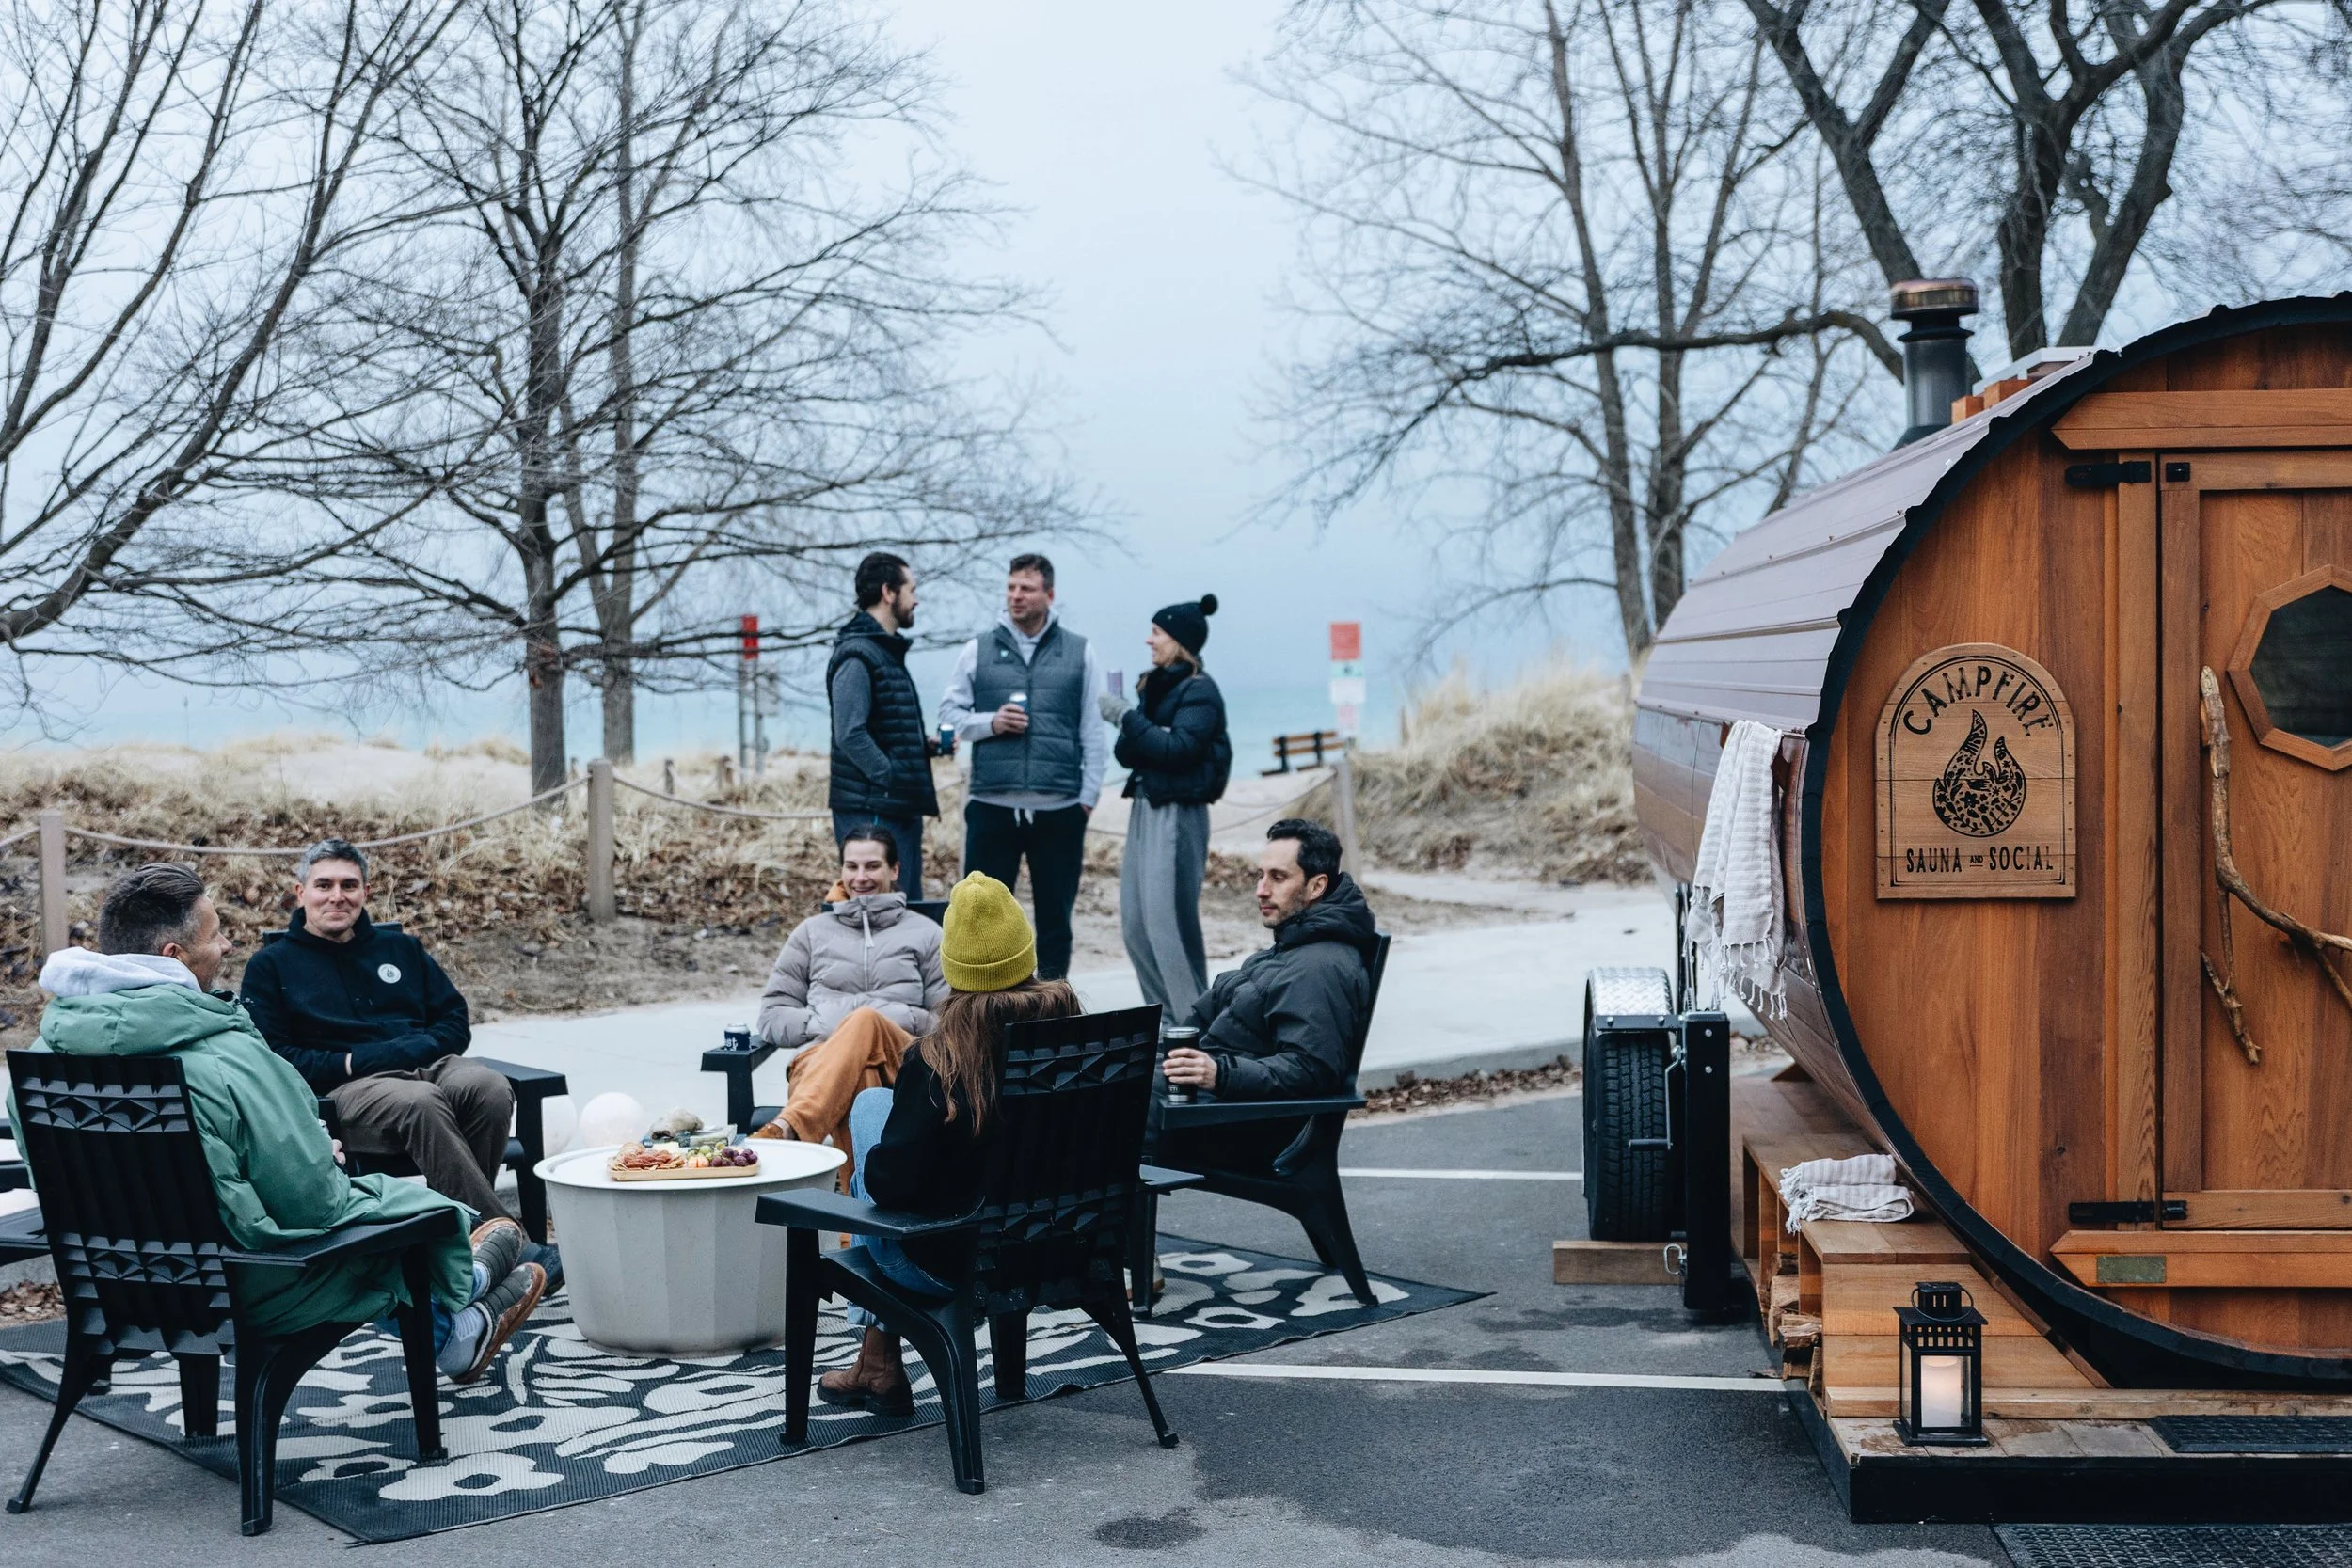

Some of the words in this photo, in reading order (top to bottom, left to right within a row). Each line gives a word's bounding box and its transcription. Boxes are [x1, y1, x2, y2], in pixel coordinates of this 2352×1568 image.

[1903, 665, 2053, 736] CAMPFIRE
[1906, 847, 1963, 873] SAUNA
[1969, 855, 1984, 864] AND
[1989, 846, 2054, 871] SOCIAL
